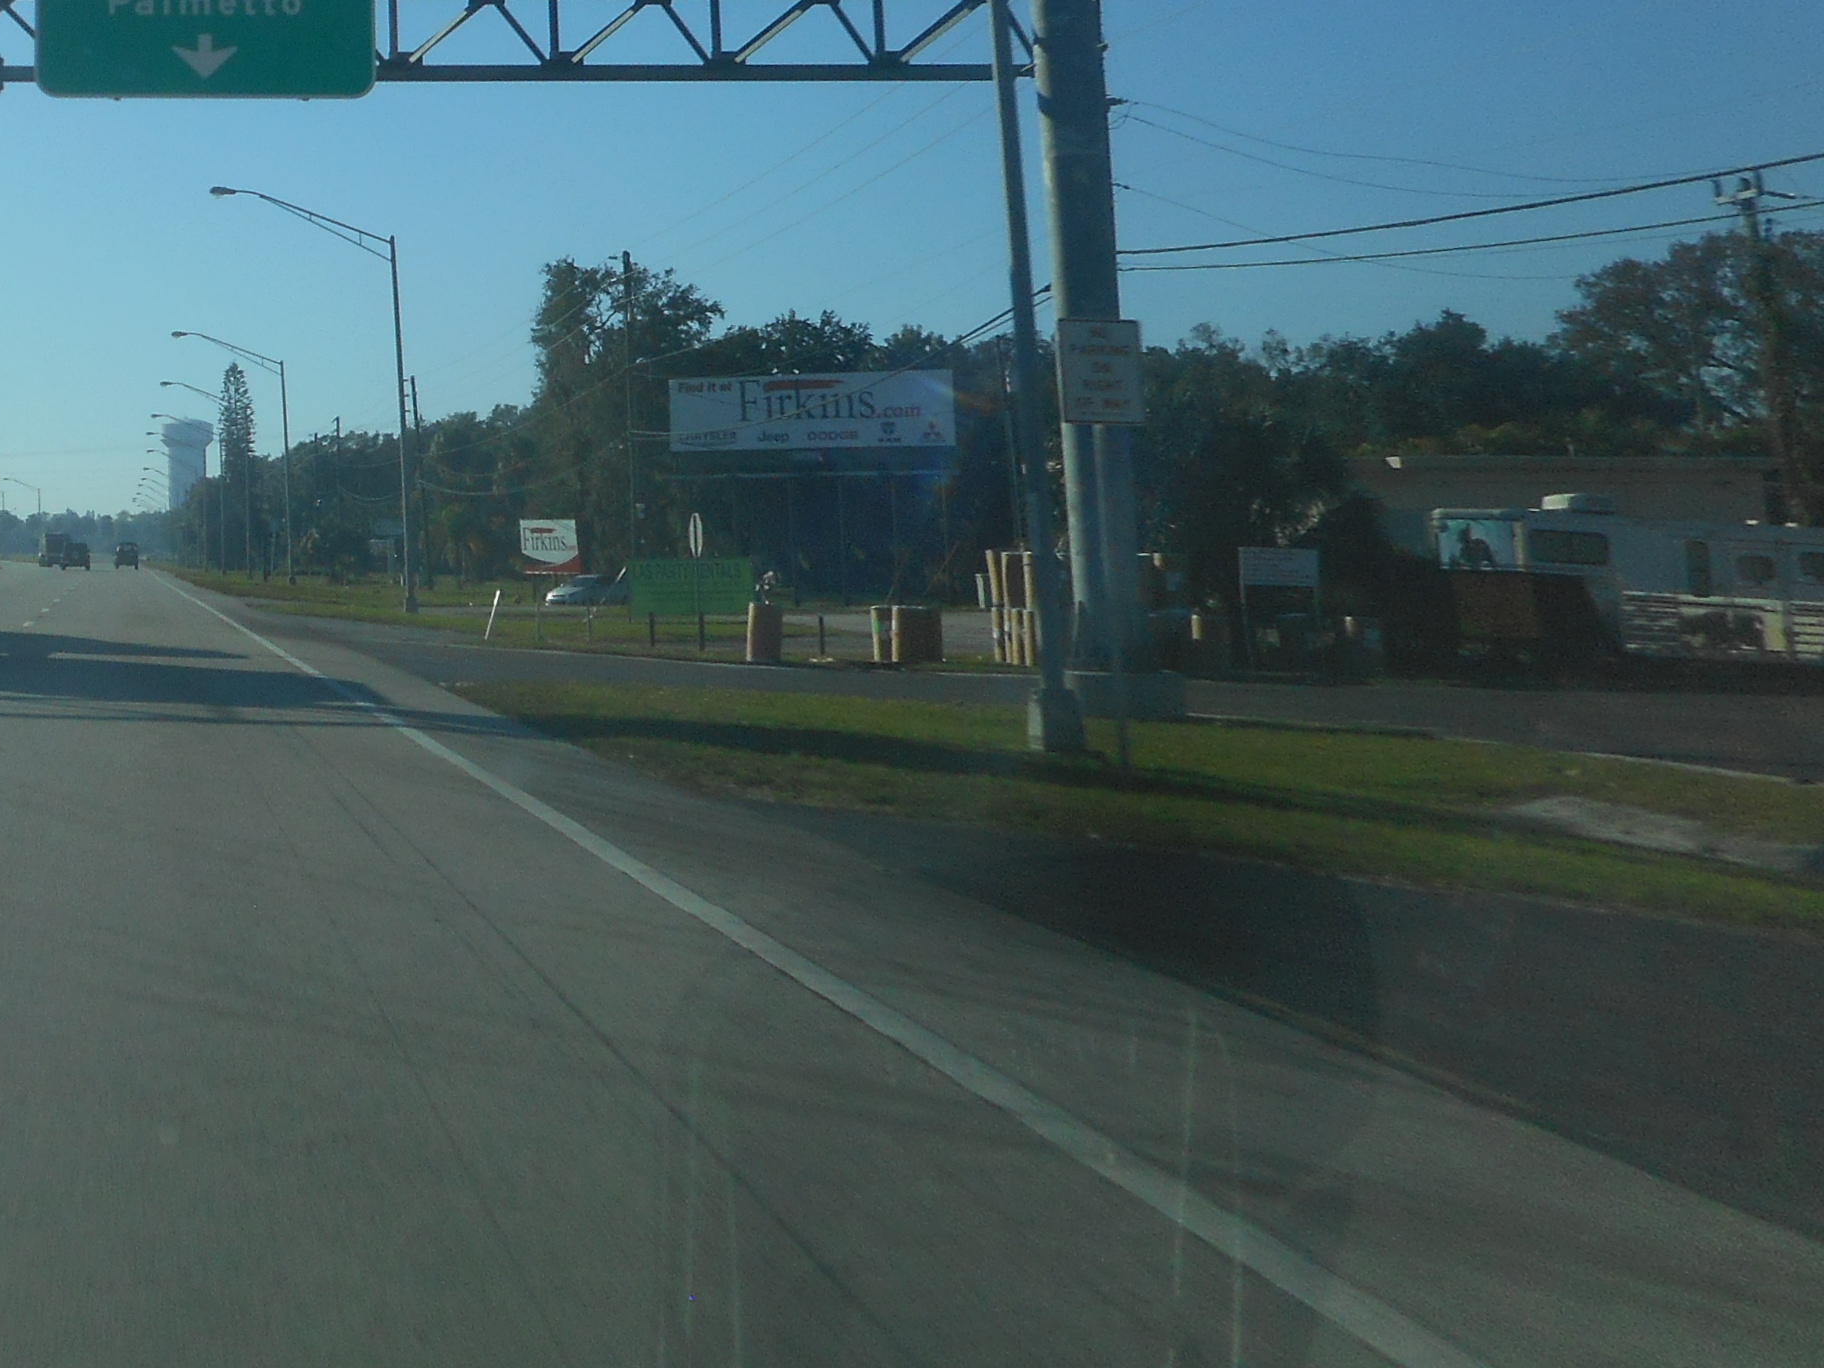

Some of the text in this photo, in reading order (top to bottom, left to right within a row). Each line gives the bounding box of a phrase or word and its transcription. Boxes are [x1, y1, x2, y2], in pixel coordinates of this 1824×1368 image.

[678, 382, 707, 393] Find
[710, 381, 718, 393] it
[758, 430, 790, 443] Jeep
[807, 430, 859, 441] DODGE
[522, 527, 576, 552] Firkins
